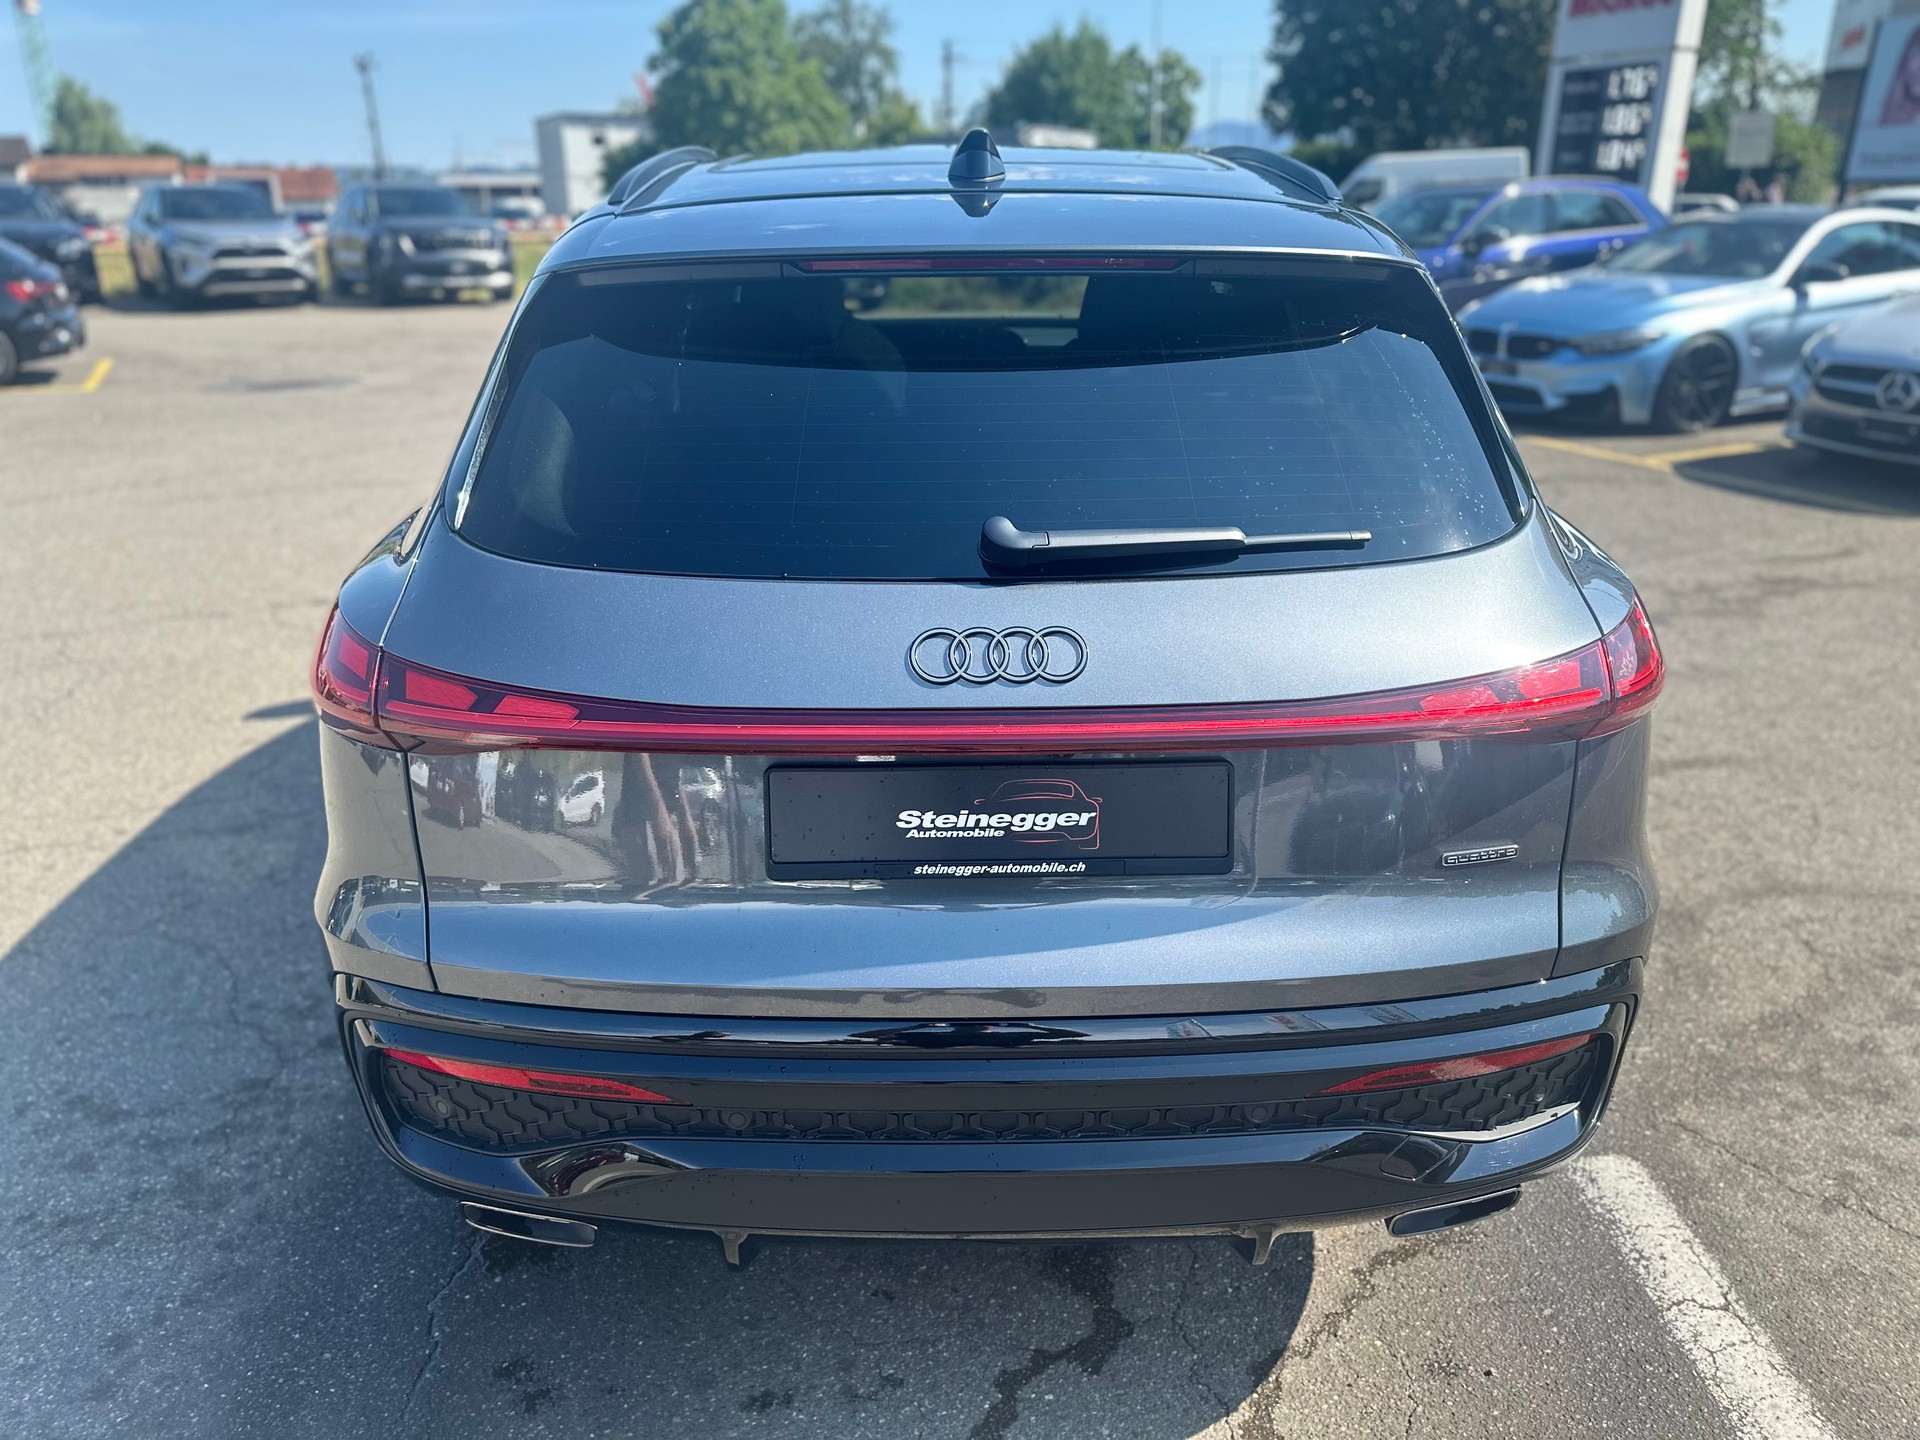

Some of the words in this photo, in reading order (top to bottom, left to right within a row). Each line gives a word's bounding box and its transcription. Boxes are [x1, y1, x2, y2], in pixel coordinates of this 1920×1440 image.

[896, 810, 1097, 831] Steinegger
[905, 828, 1005, 838] Automobile
[1447, 848, 1516, 864] quattro
[914, 862, 1086, 876] steinegger-automobile.ch
